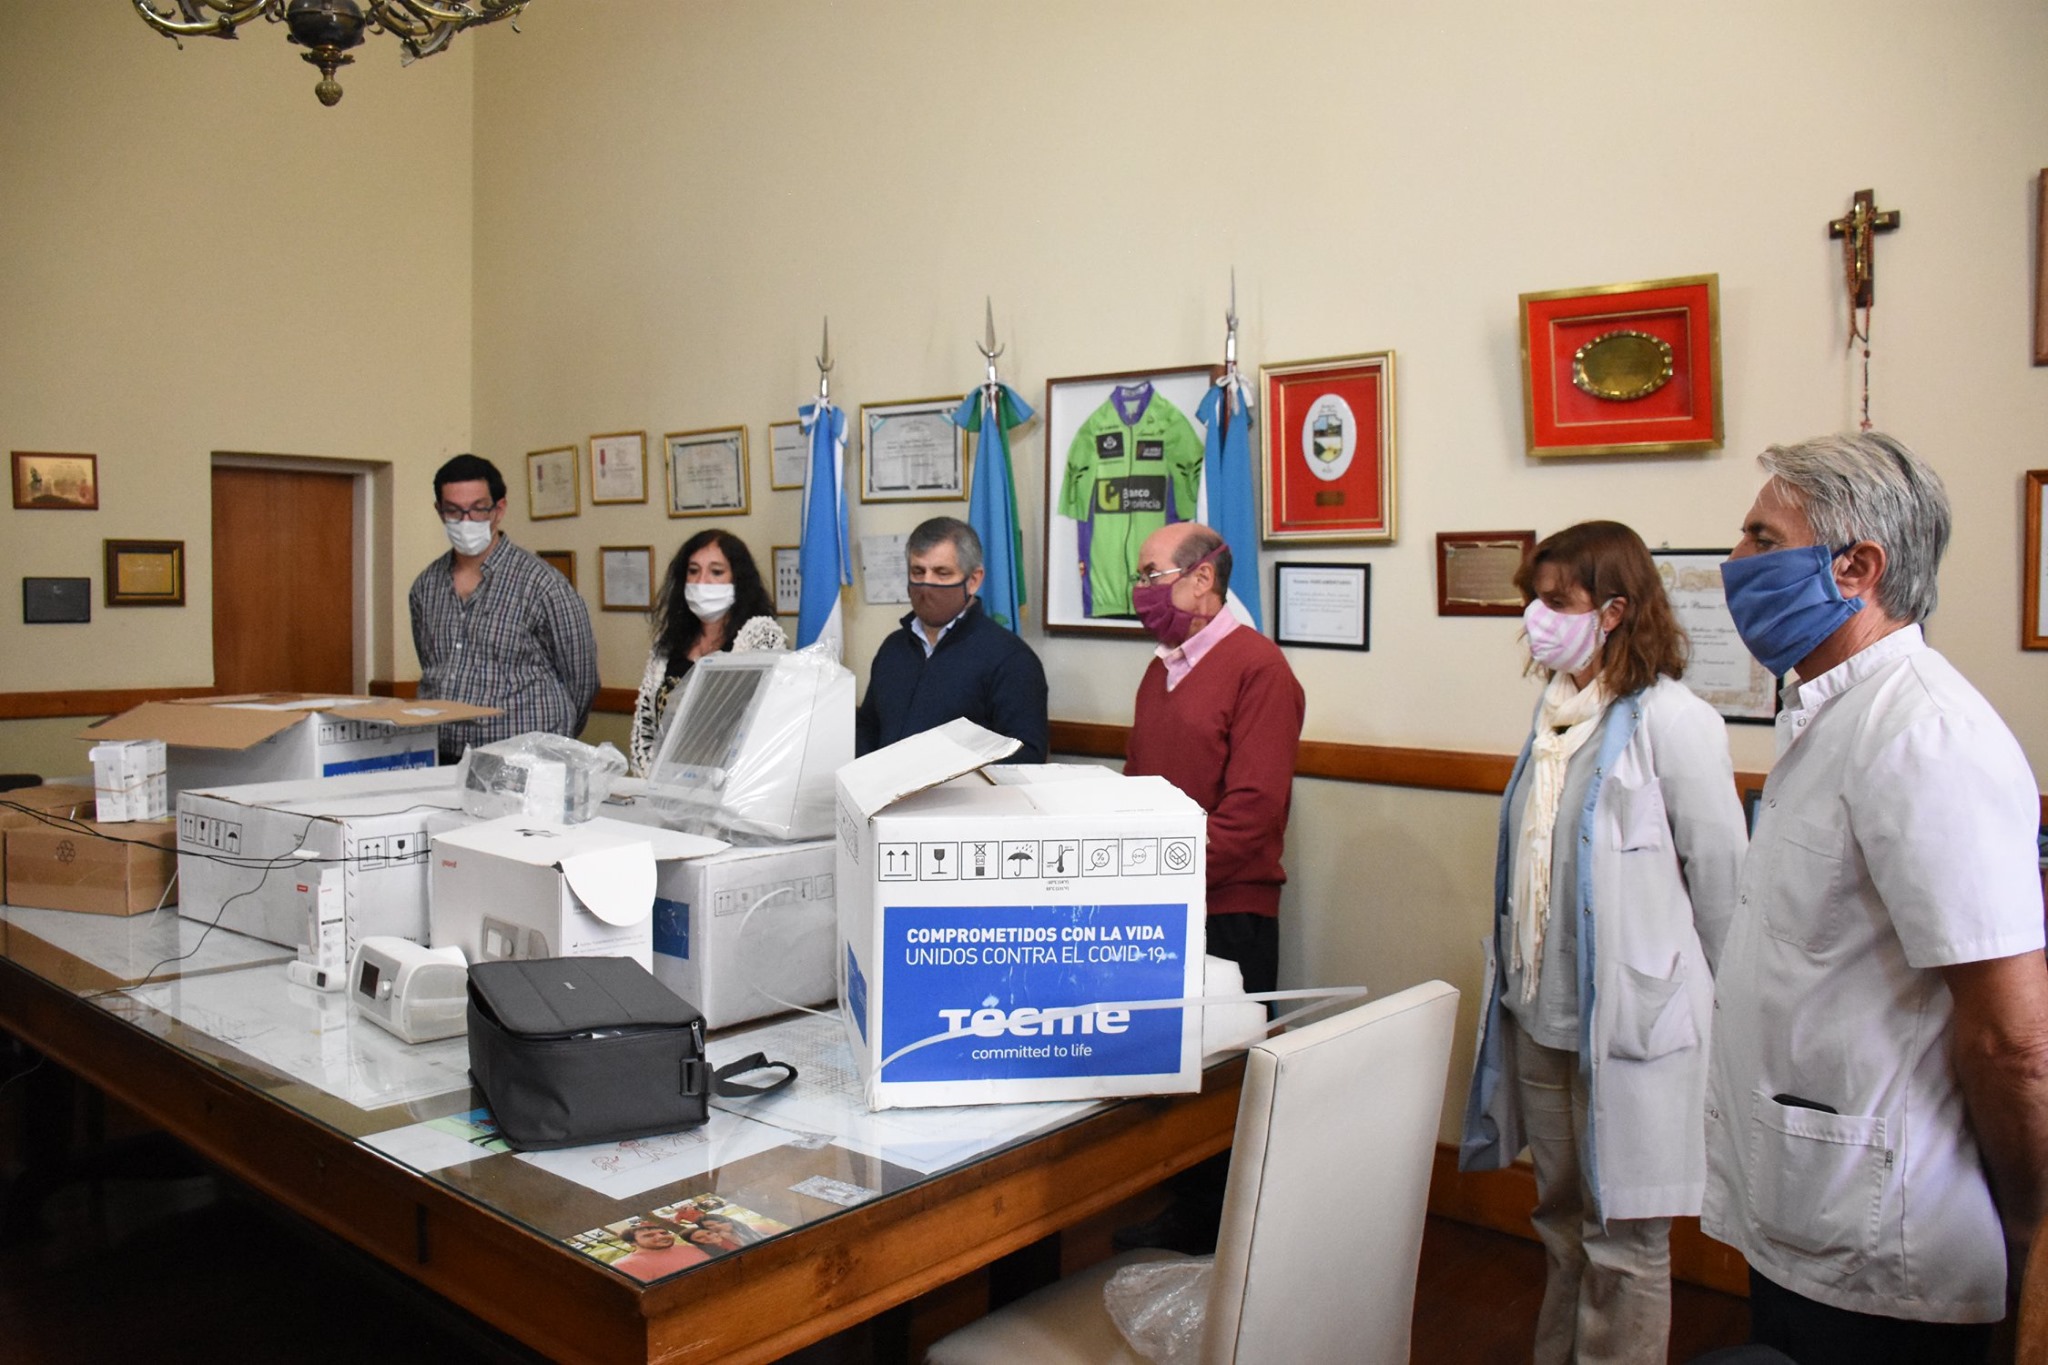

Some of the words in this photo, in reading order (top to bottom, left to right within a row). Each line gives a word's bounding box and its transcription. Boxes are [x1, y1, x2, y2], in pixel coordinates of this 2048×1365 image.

[906, 927, 1057, 943] COMPROMETIDOS
[1061, 926, 1096, 942] CON
[1100, 926, 1122, 941] LA
[1125, 925, 1165, 940] VIDA
[905, 947, 978, 966] UNIDOS
[982, 946, 1058, 965] CONTRA
[1062, 946, 1084, 963] EL
[1088, 945, 1165, 964] COVID-19
[971, 1044, 1051, 1060] committed
[1054, 1045, 1068, 1058] to
[1071, 1043, 1093, 1057] life
